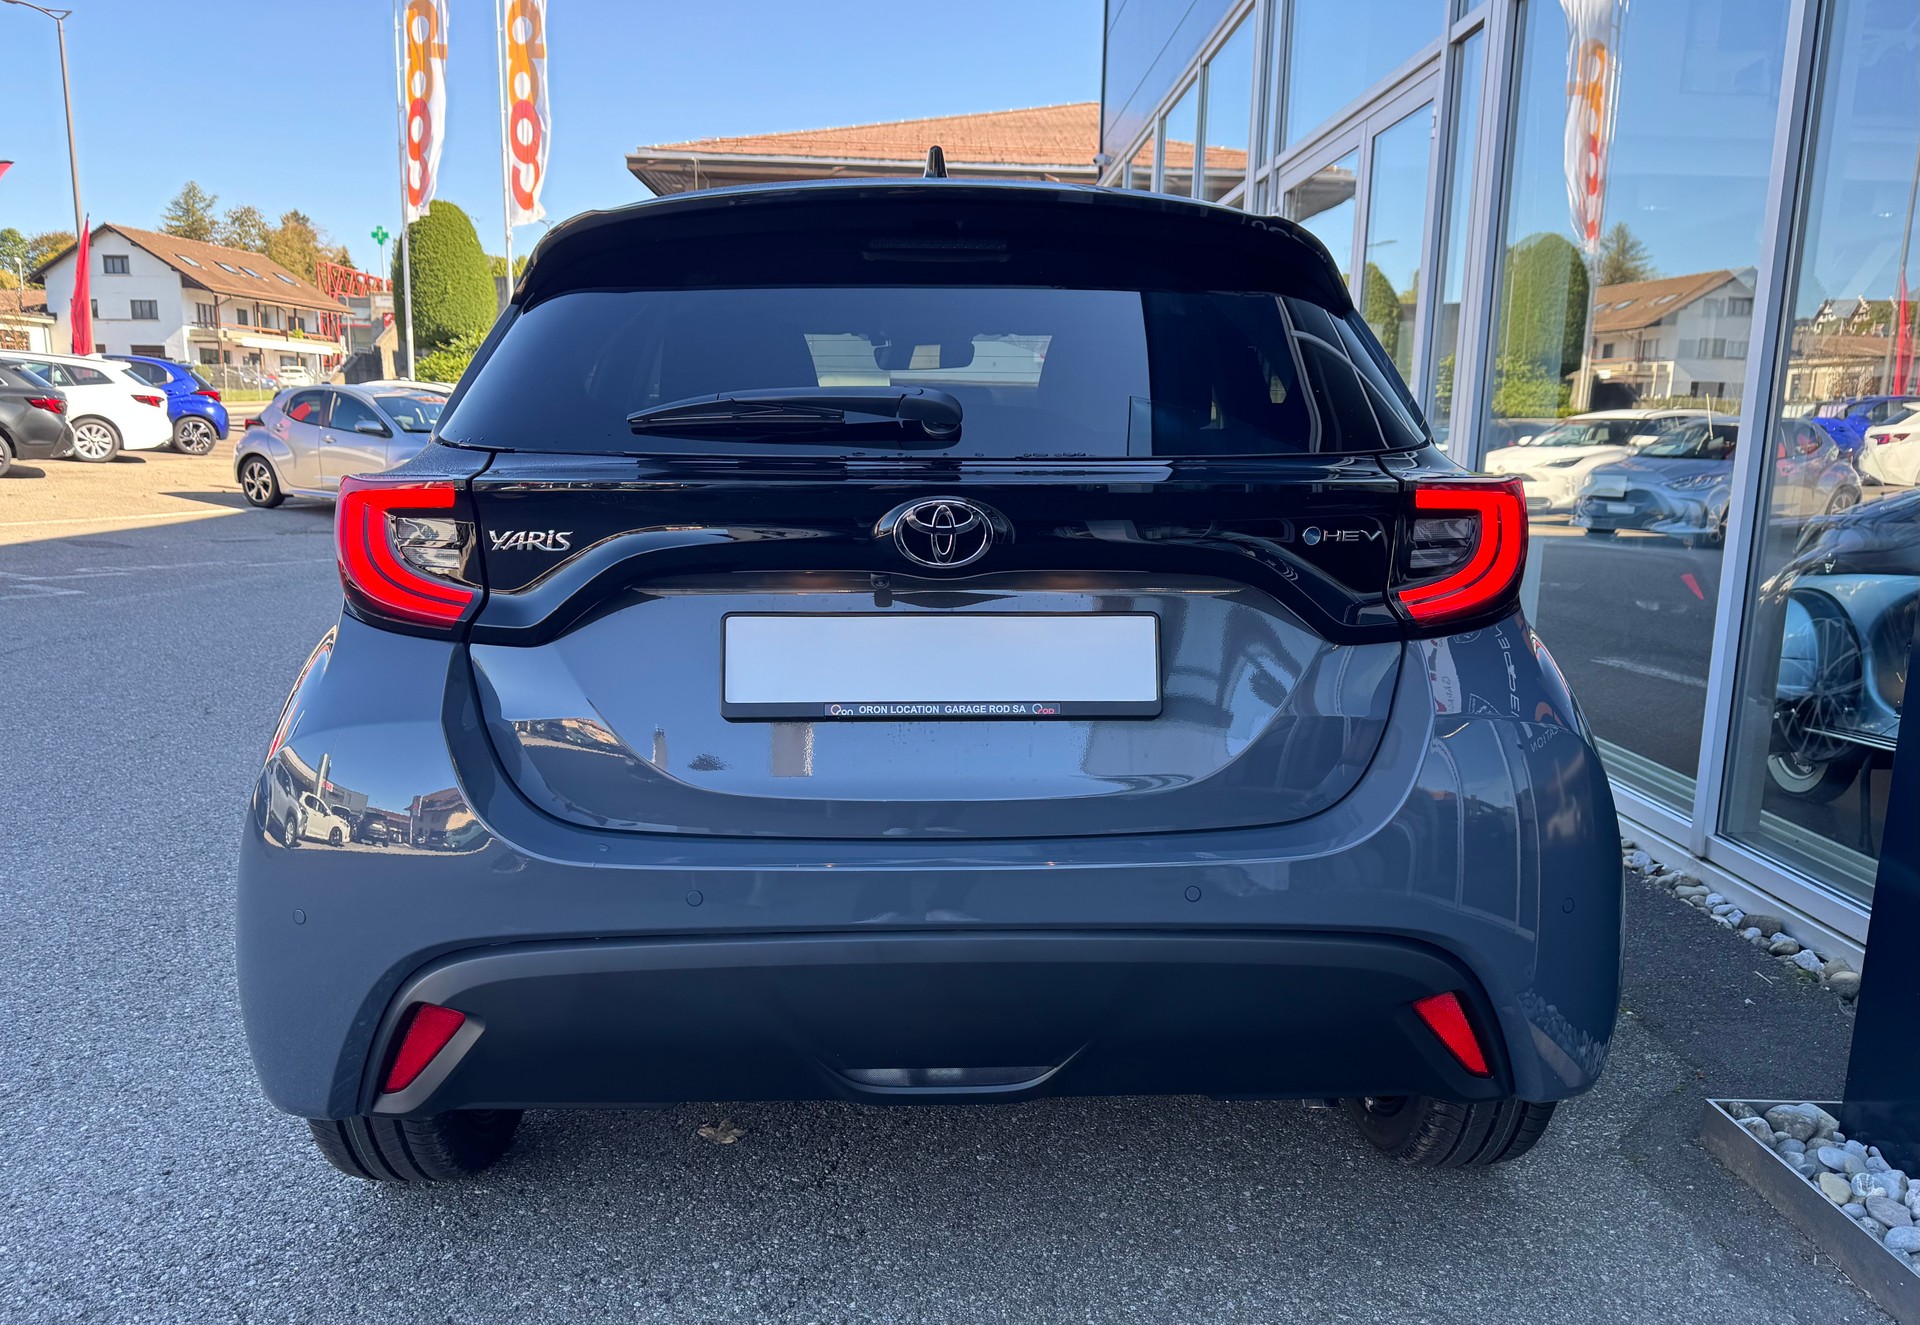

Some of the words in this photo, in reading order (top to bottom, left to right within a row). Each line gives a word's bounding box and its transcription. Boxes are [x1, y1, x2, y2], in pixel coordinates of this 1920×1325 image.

[1322, 529, 1382, 542] HEV
[858, 705, 888, 714] ORON
[890, 705, 940, 714] LOCATION
[944, 704, 987, 714] GARAGE
[988, 704, 1011, 714] ROD
[1012, 704, 1027, 714] SA
